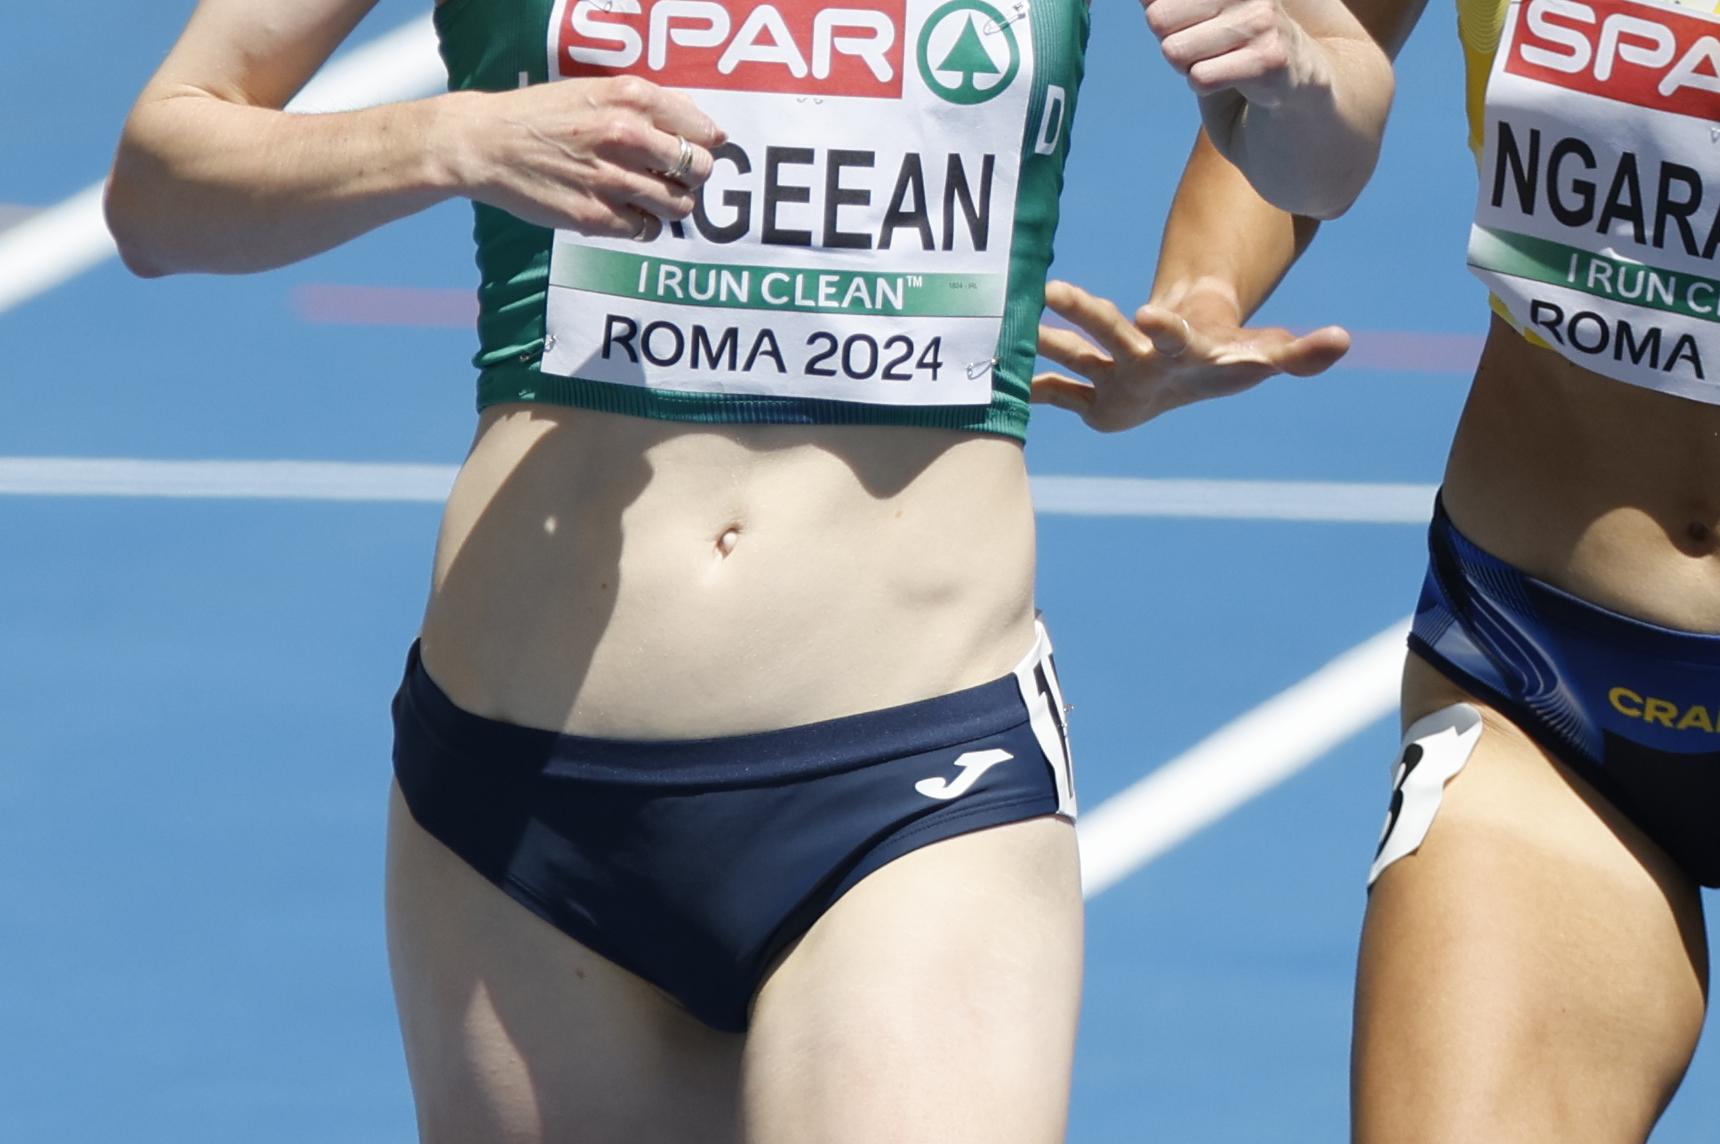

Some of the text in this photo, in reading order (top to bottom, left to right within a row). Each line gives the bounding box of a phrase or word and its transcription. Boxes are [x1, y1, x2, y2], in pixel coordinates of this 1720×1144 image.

[670, 141, 996, 252] GEEAN
[637, 260, 650, 294] I
[656, 264, 750, 303] RUN
[1565, 252, 1580, 284] I
[1585, 255, 1678, 308] RUN
[602, 313, 944, 382] ROMA 2024
[1529, 298, 1706, 381] ROMA
[1033, 653, 1074, 800] 1
